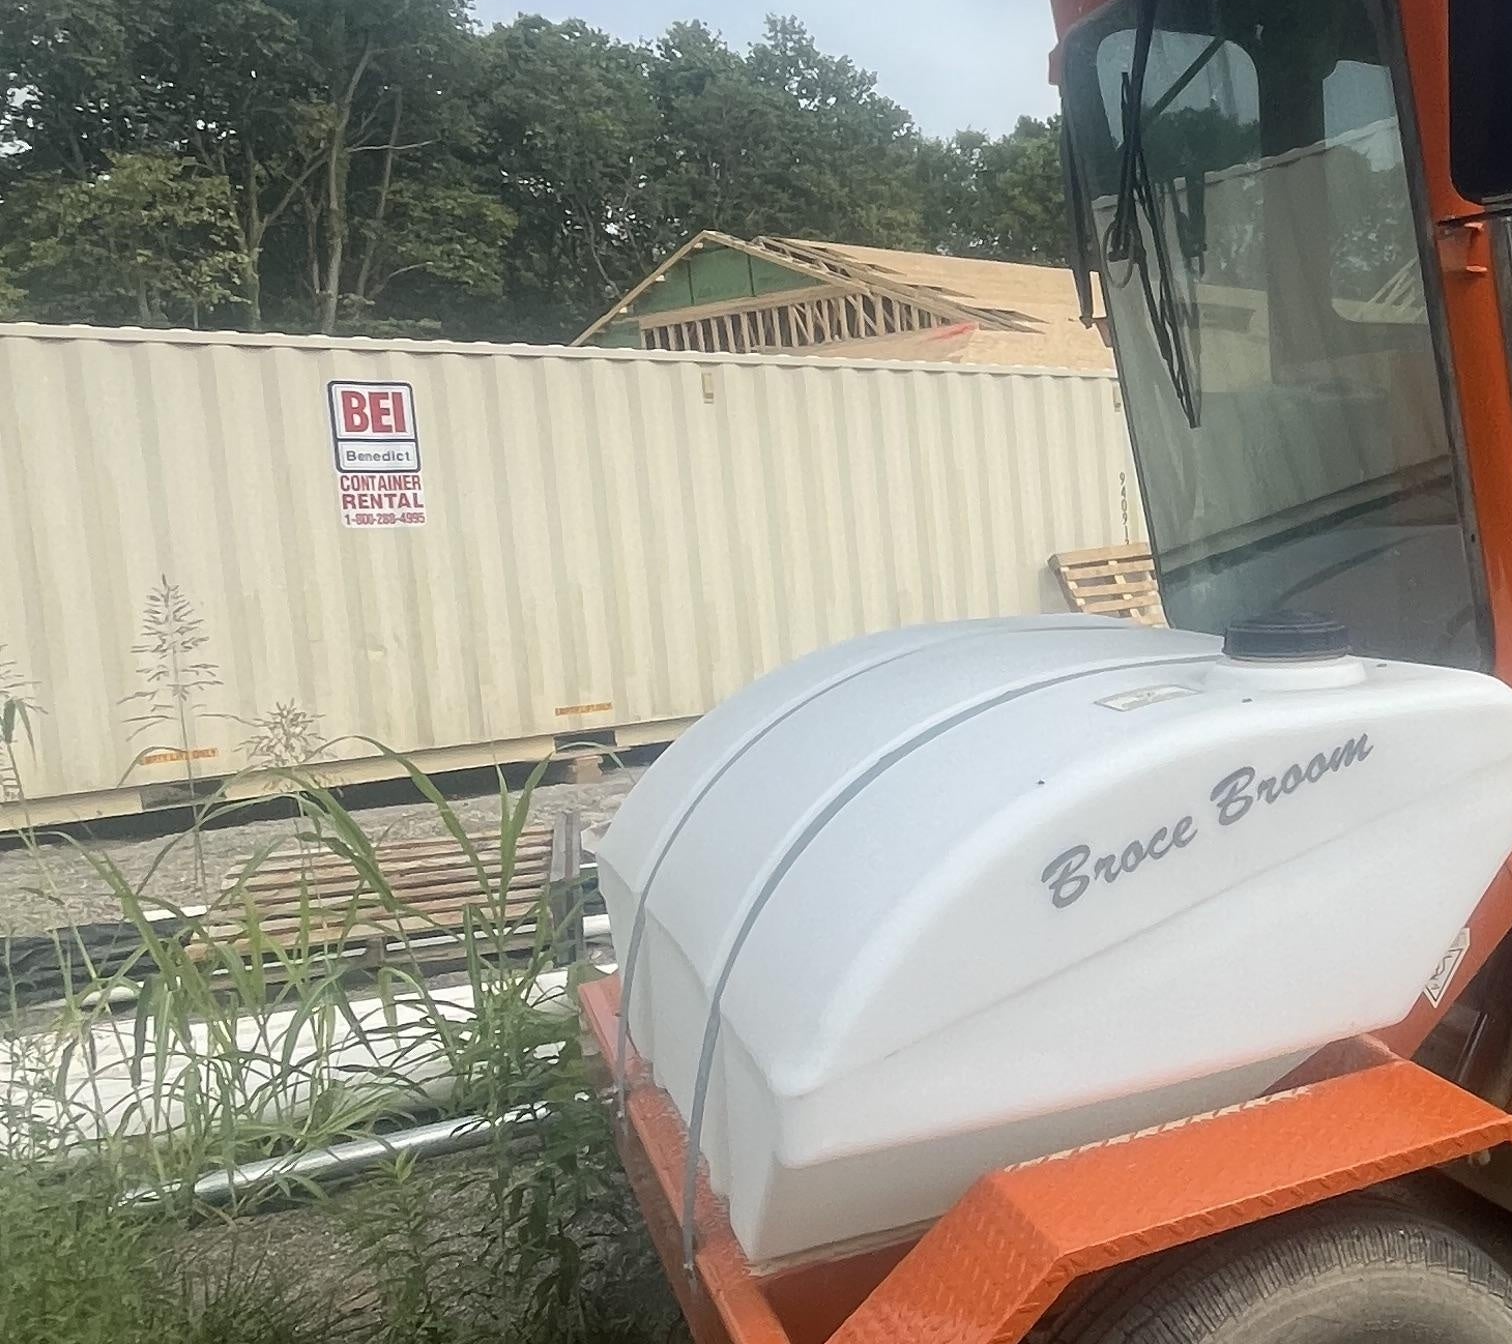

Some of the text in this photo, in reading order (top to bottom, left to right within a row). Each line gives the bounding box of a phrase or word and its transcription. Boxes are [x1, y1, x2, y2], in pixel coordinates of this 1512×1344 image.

[341, 391, 407, 433] BEI
[346, 450, 411, 462] Benedict
[340, 475, 422, 492] CONTAINER
[342, 493, 424, 510] RENTAL
[1041, 733, 1374, 909] Broce Broom
